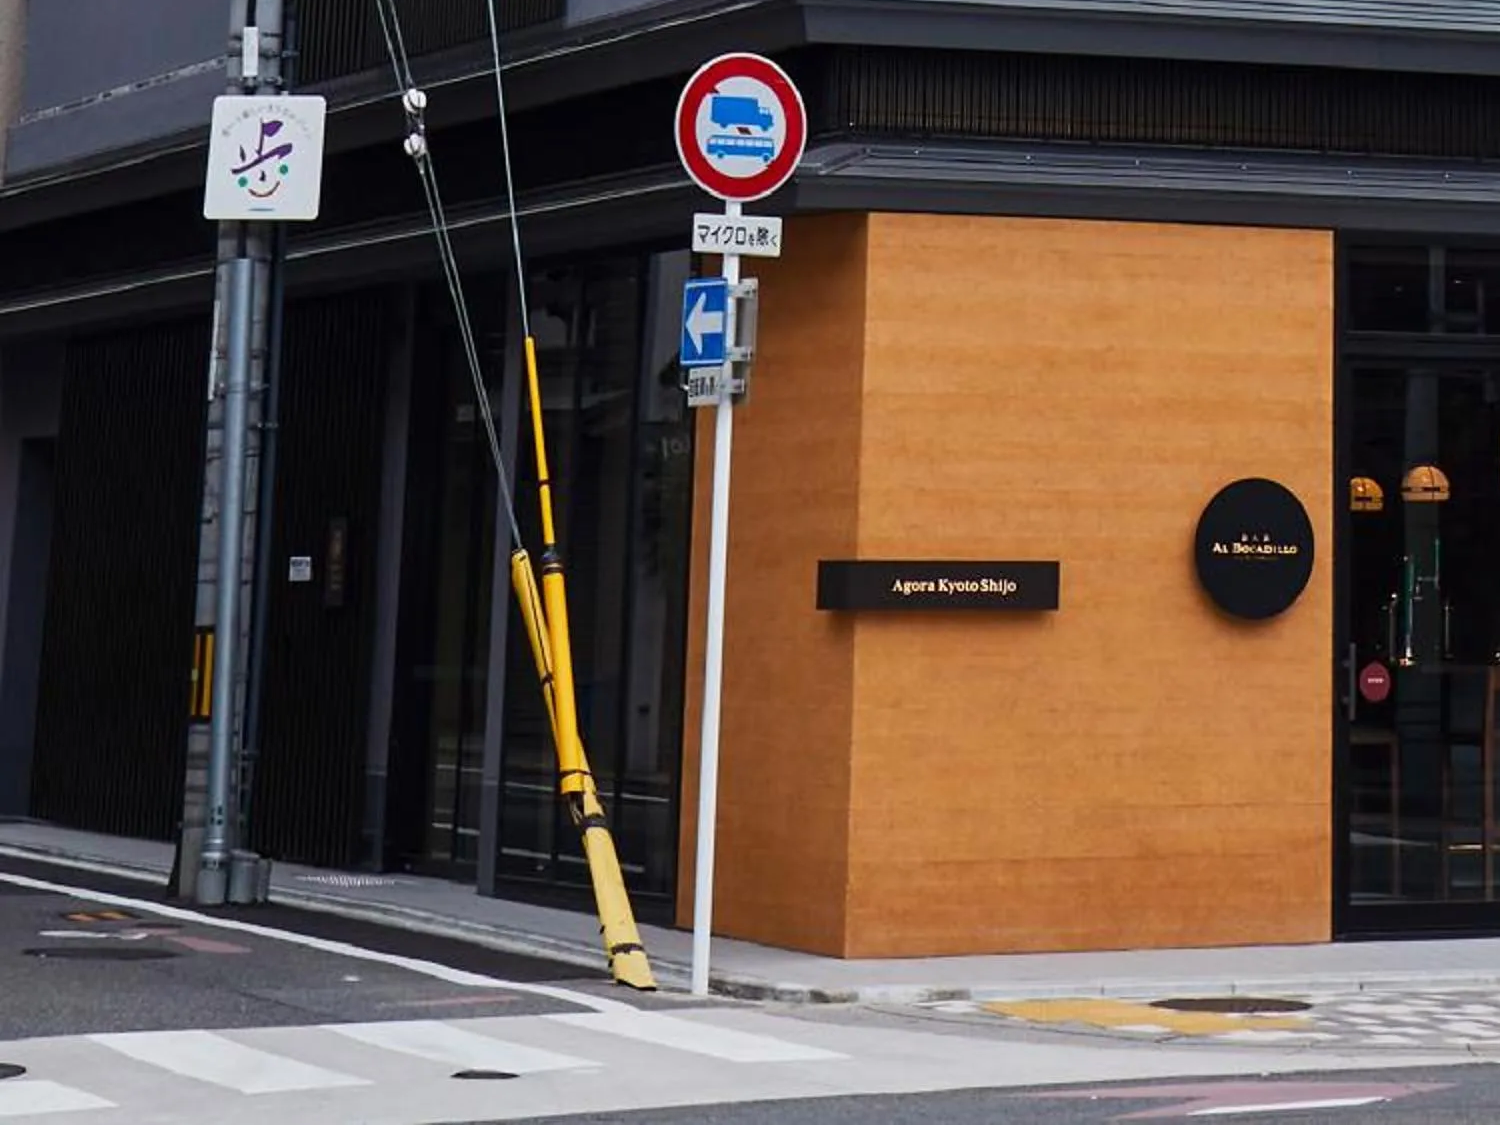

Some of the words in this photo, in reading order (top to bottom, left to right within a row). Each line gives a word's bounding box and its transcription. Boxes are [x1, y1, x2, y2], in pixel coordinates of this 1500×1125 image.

[697, 224, 778, 248] マイクロを除く
[892, 578, 935, 595] Agora
[938, 578, 979, 595] Kyoto
[980, 578, 1017, 595] Shijo
